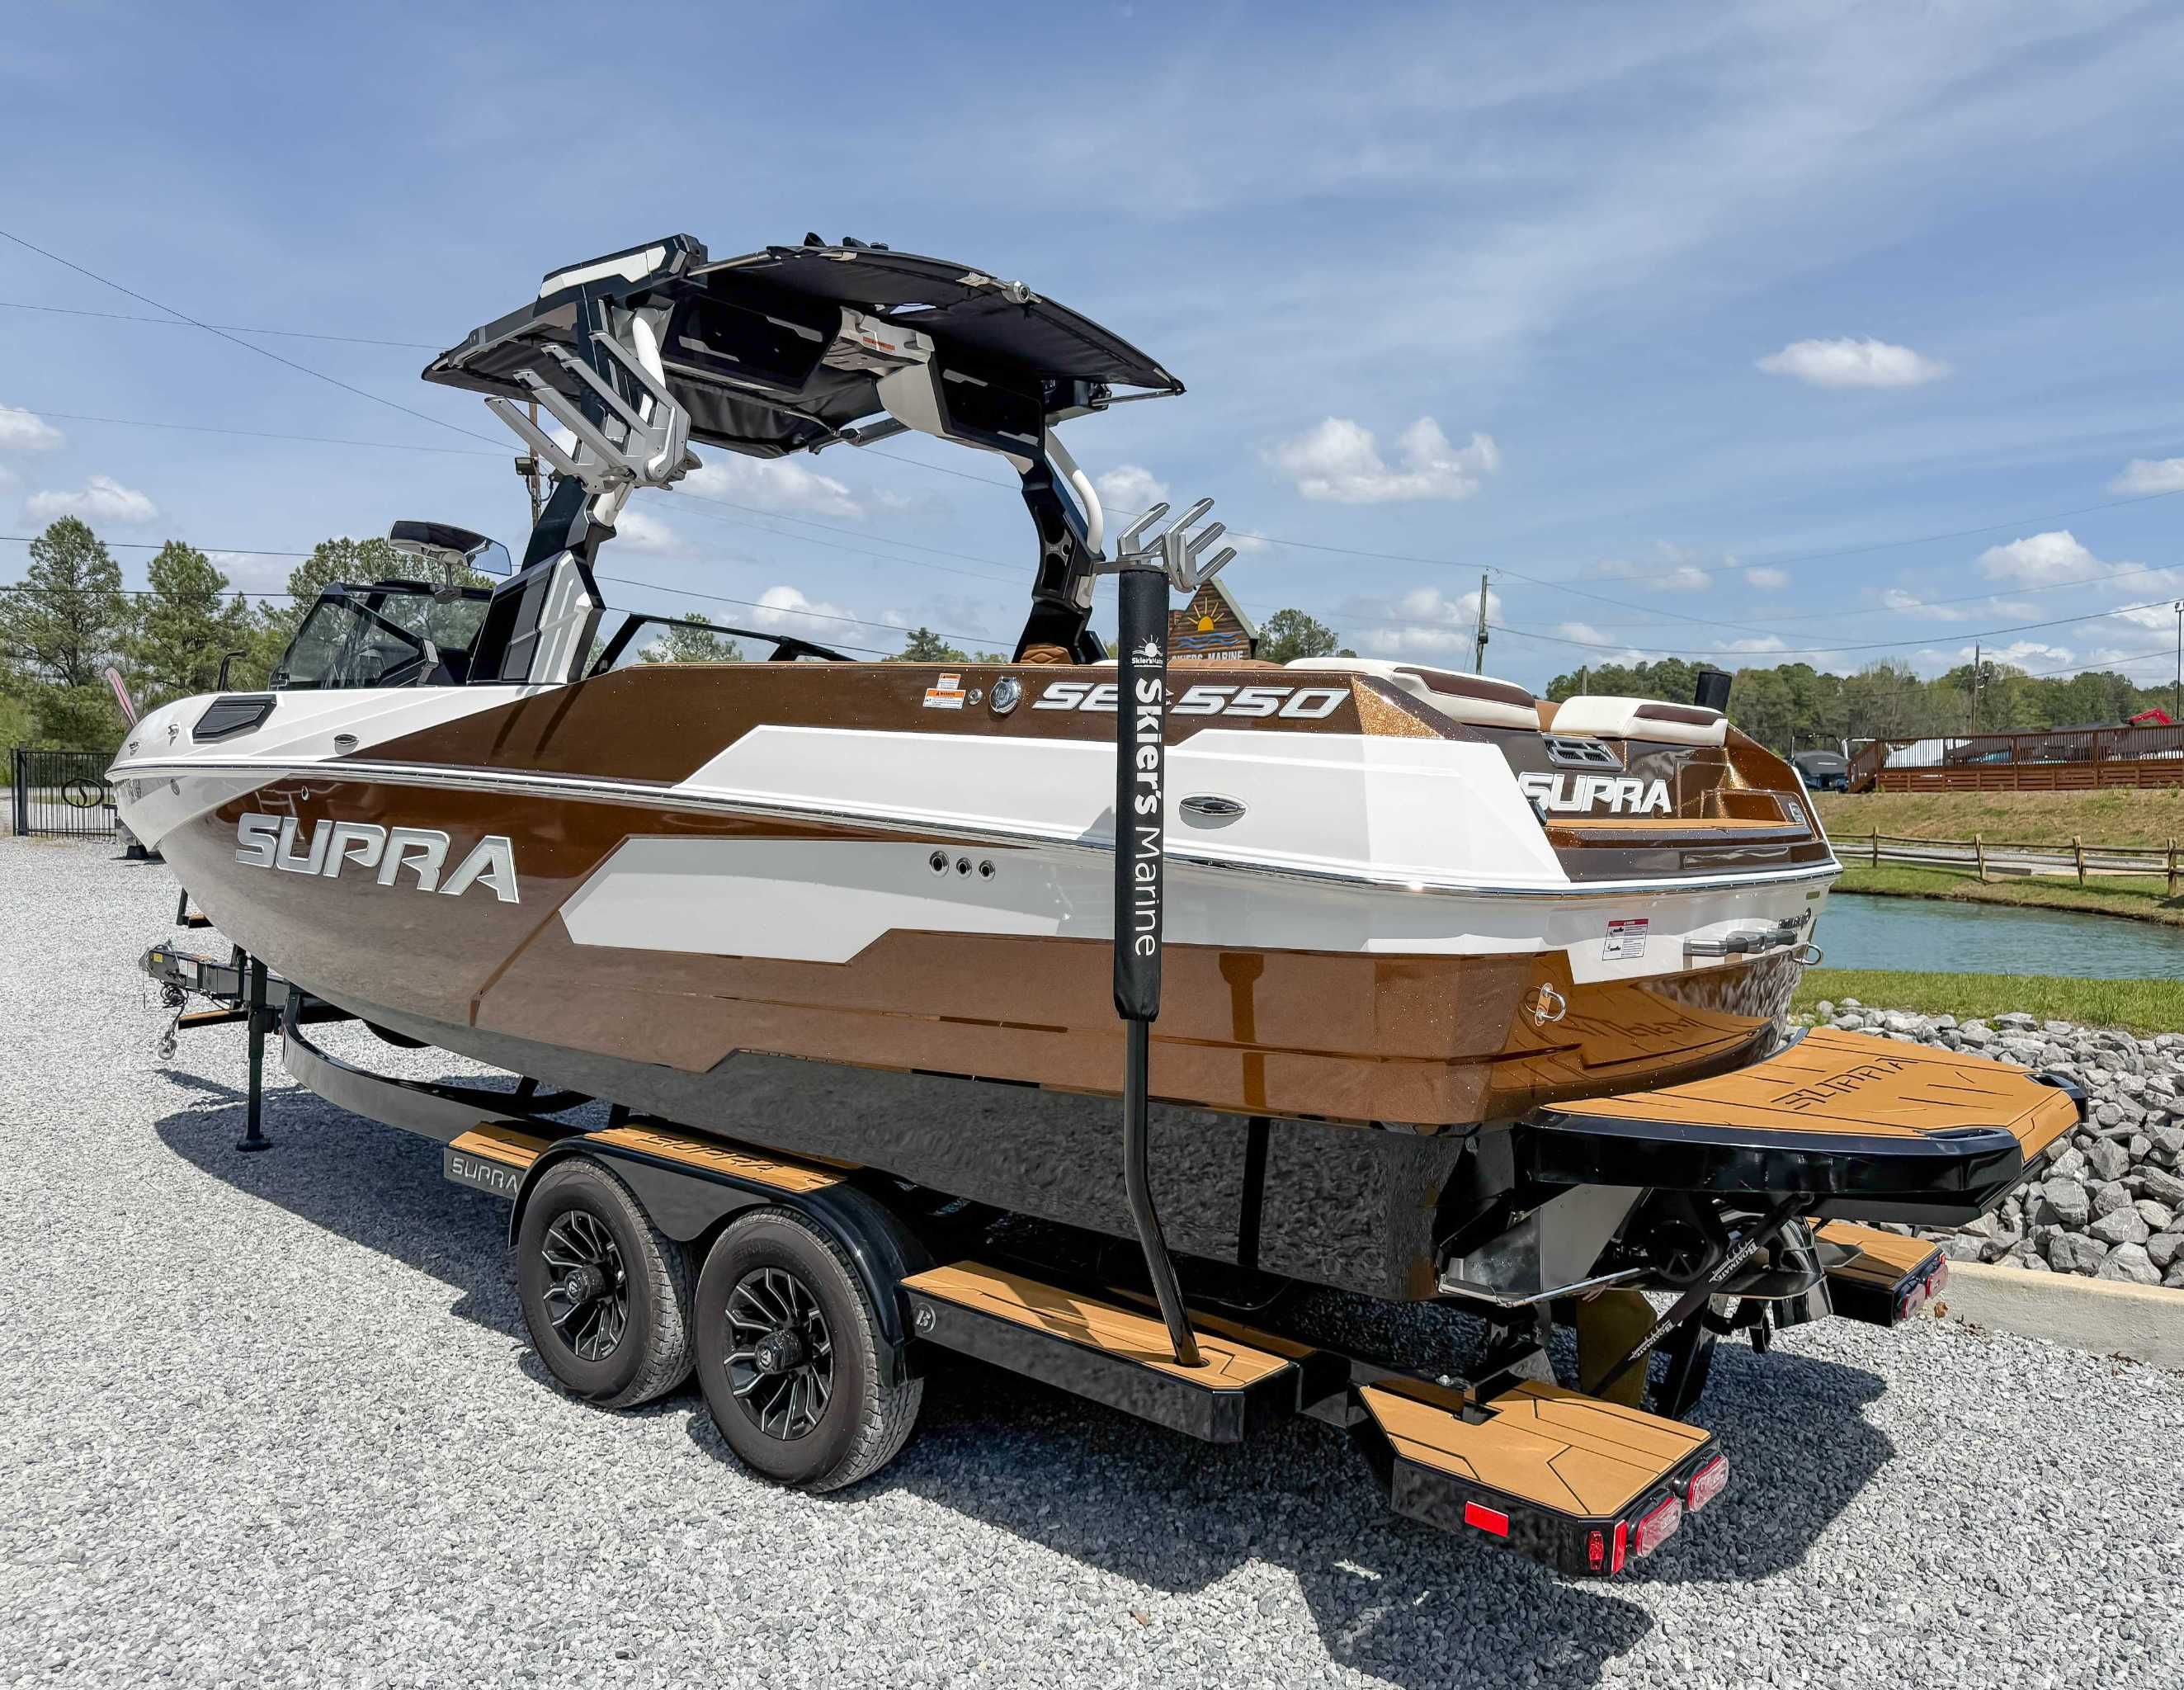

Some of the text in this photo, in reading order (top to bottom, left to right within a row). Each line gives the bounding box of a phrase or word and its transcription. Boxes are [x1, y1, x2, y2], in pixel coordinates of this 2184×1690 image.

[1207, 650, 1243, 661] MARINE
[1169, 686, 1351, 719] 550
[1134, 678, 1162, 814] Skier's
[1517, 771, 1672, 814] SUPRA
[235, 812, 520, 904] SUPRA
[1135, 827, 1160, 956] Marine
[1770, 1057, 1920, 1110] SUPRA
[450, 1157, 518, 1193] SUPRA
[634, 1135, 784, 1173] SUPRA
